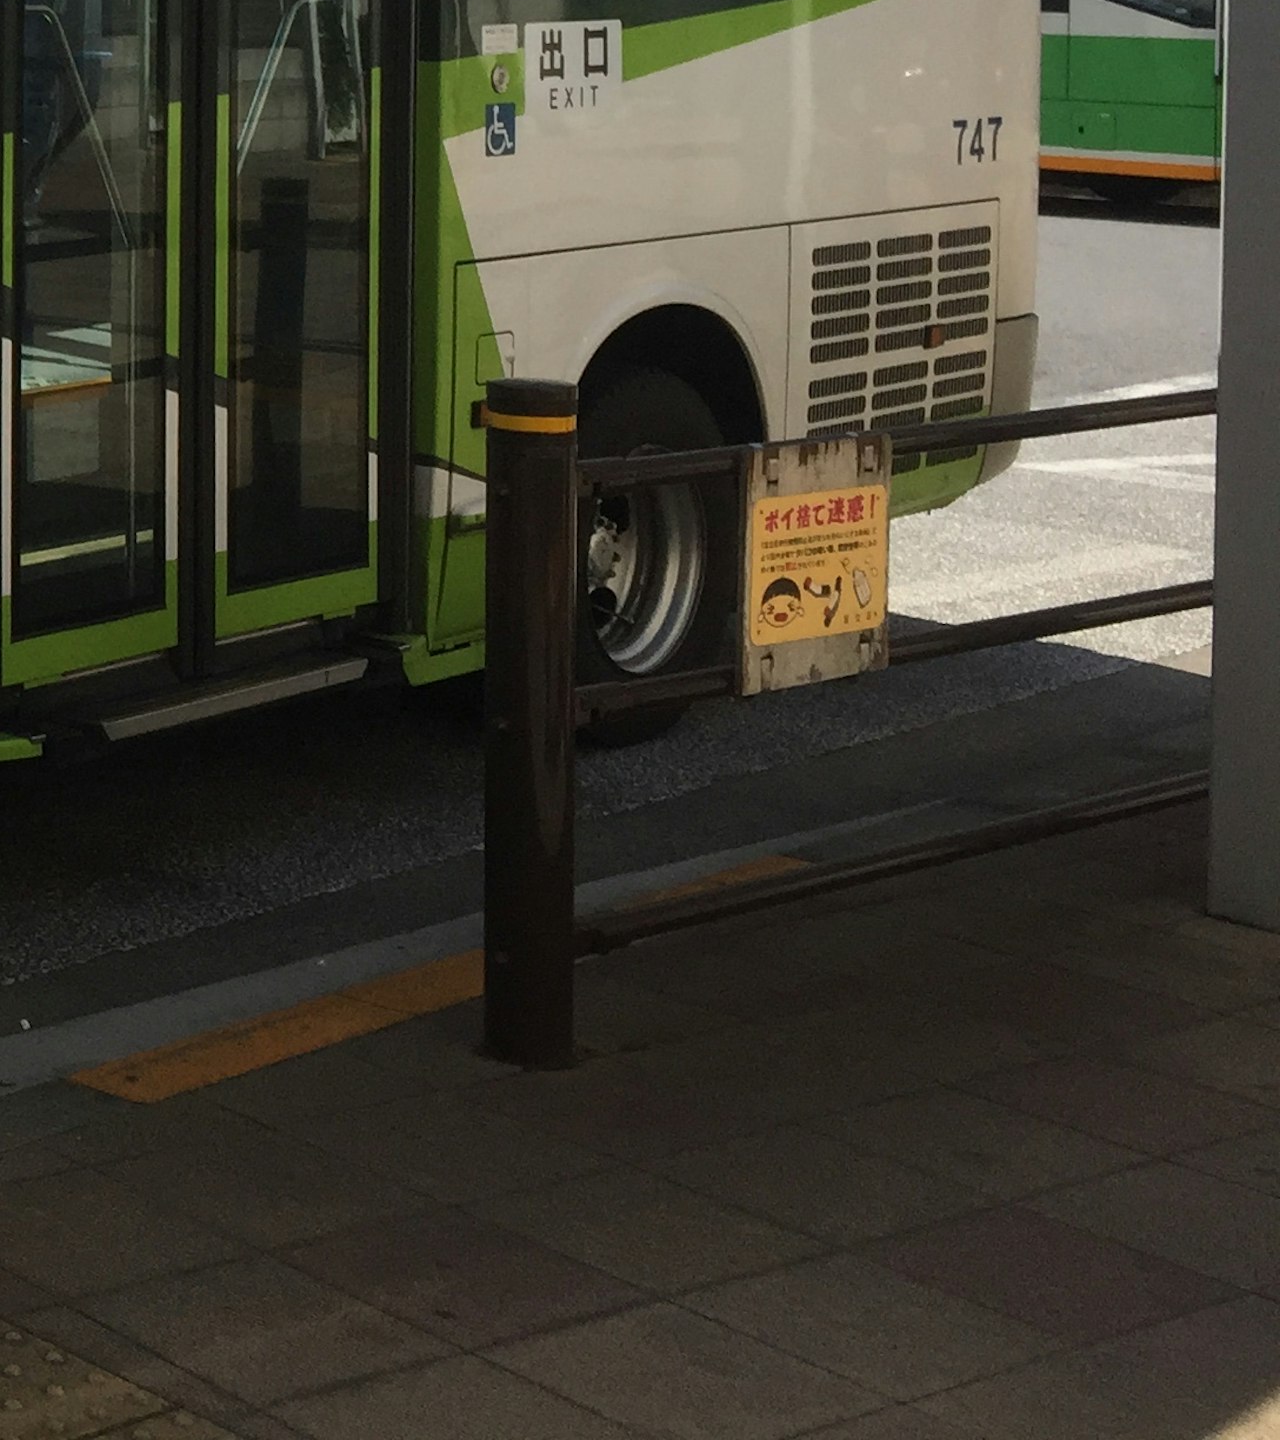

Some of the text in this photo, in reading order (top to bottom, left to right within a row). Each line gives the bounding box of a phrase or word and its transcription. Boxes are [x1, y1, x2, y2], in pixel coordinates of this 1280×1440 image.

[539, 26, 609, 82] 出口
[549, 85, 600, 111] EXIT
[952, 116, 1003, 166] 747
